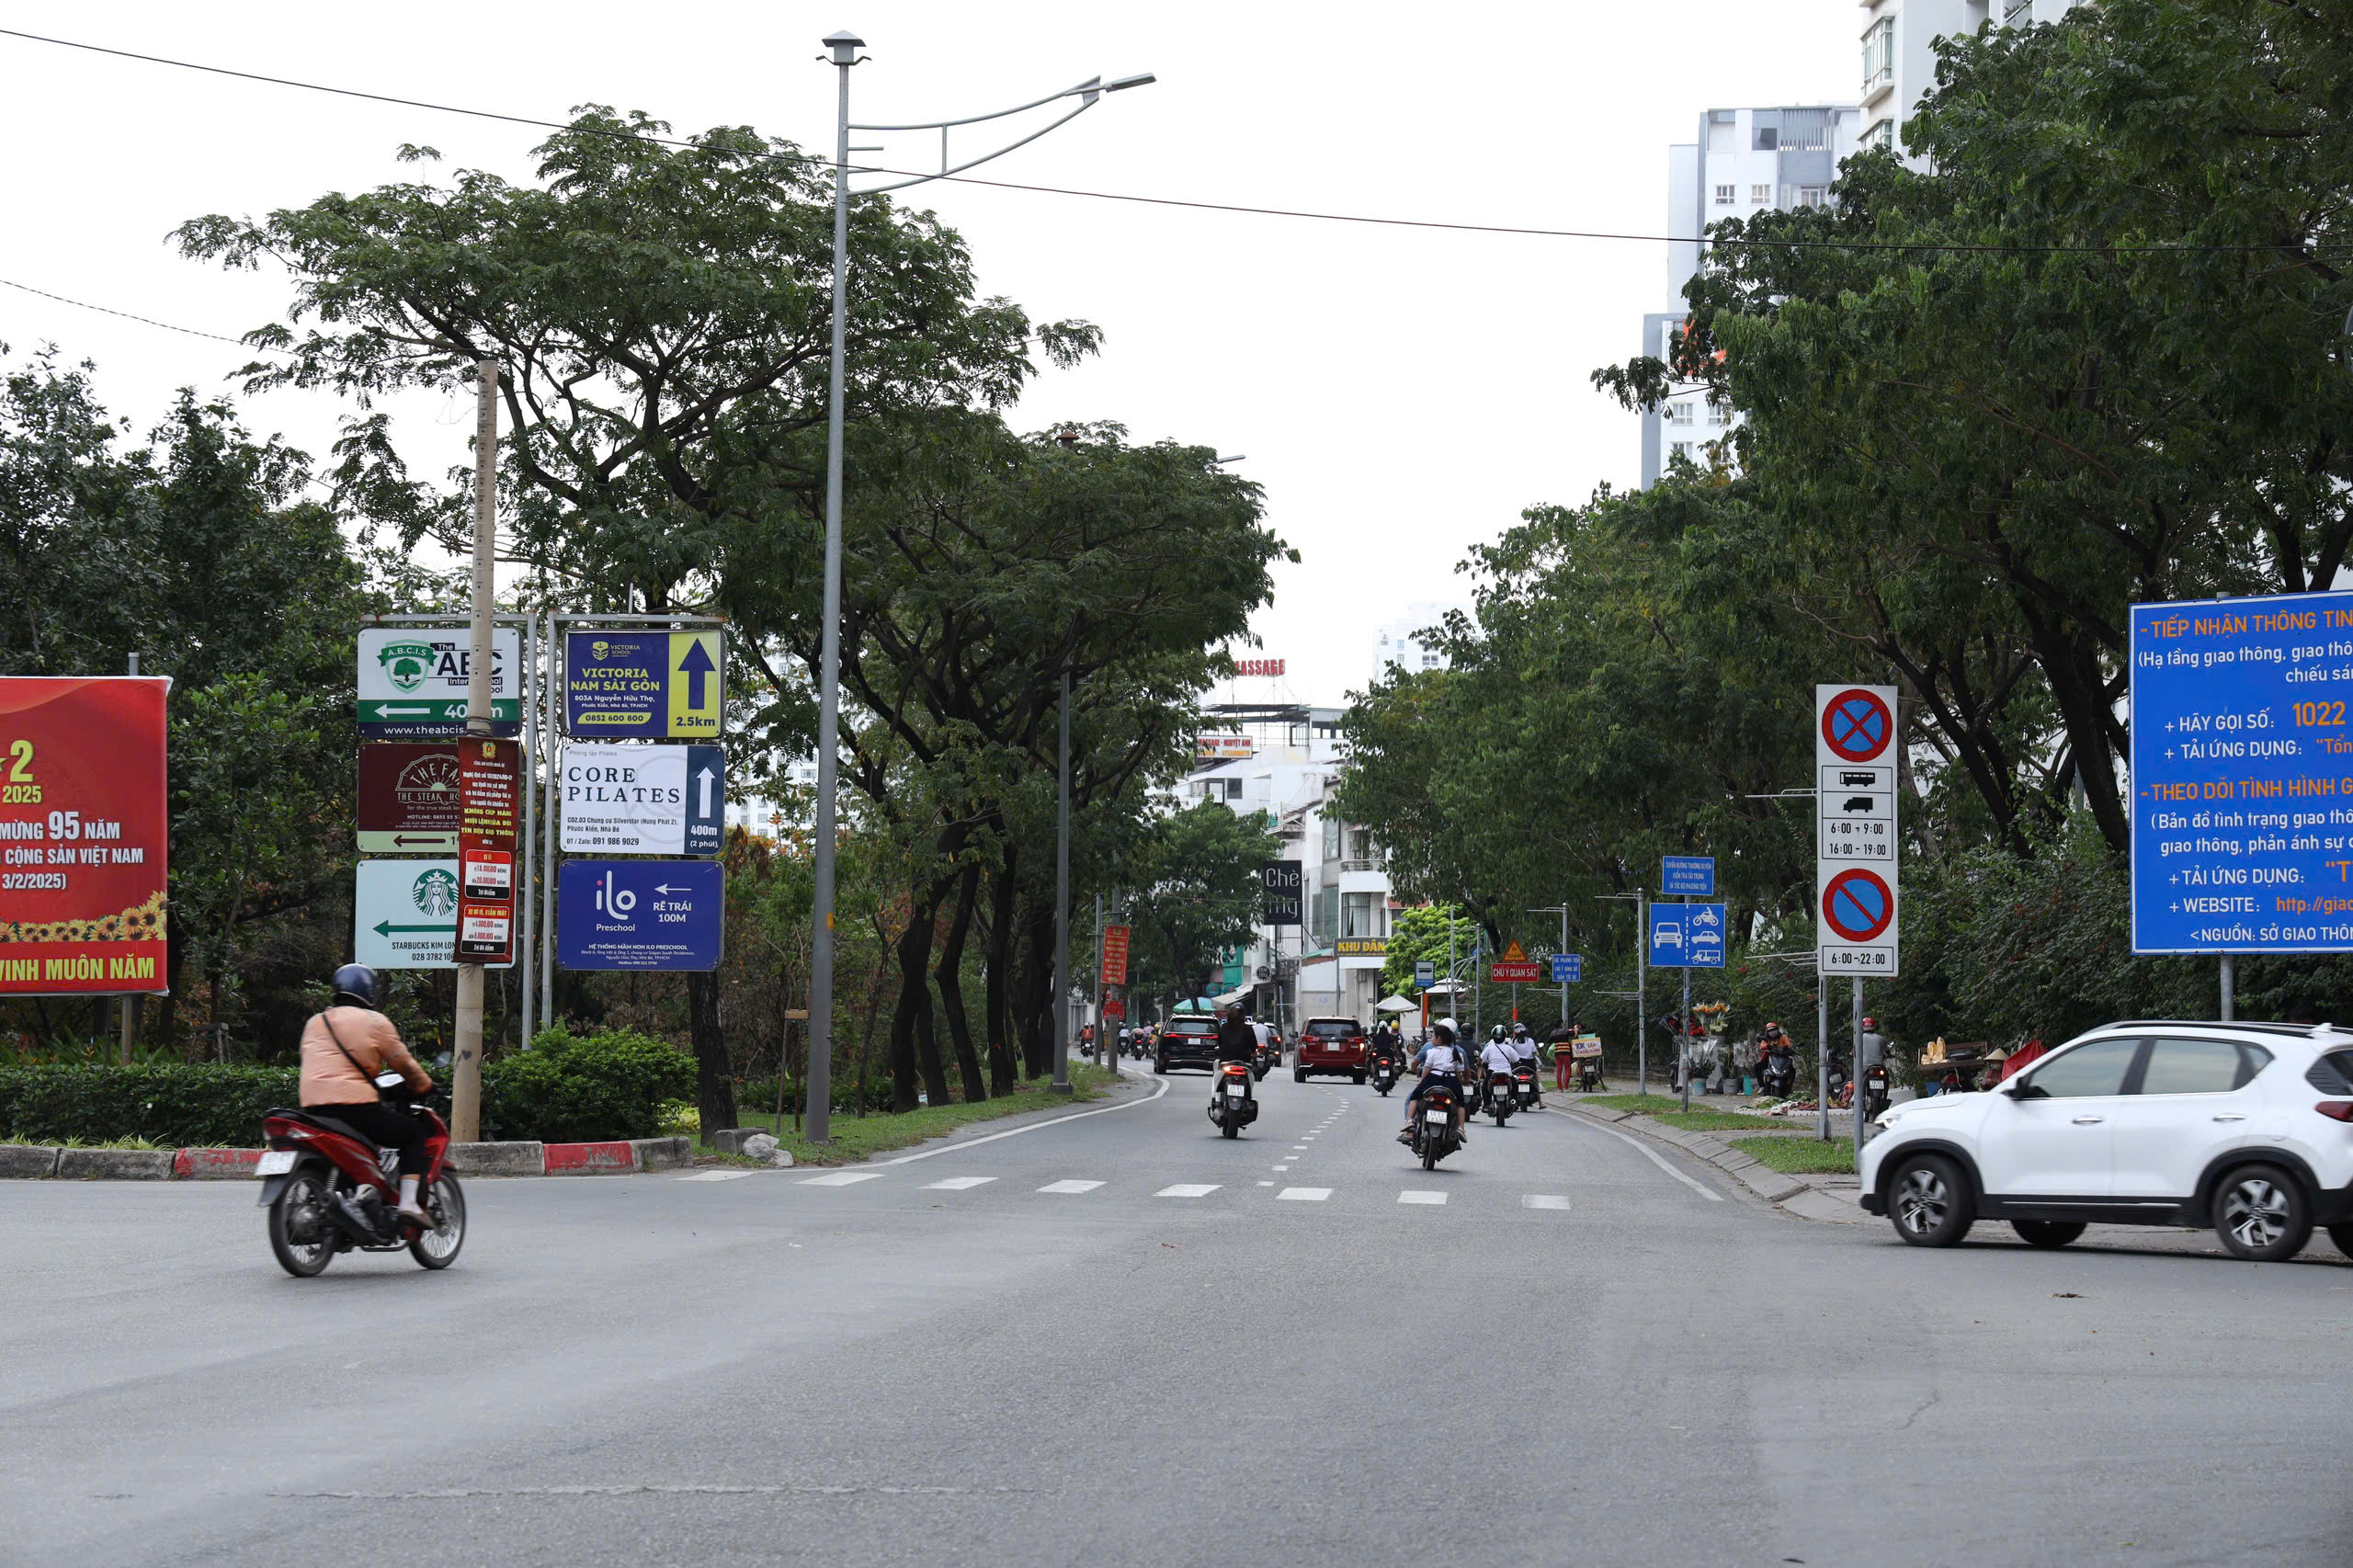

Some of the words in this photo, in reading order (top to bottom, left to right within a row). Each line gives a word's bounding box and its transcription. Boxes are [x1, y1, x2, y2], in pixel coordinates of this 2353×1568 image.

[2151, 613, 2189, 638] TIẾP
[2195, 613, 2247, 639] NHẬN
[2253, 609, 2316, 631] THÔNG
[2324, 610, 2353, 628] TIN
[387, 647, 427, 656] A.B.C.I.S
[2138, 651, 2163, 669] (Hạ
[2167, 647, 2200, 668] tầng
[2203, 652, 2234, 667] giao
[2239, 646, 2287, 663] thông,
[2291, 643, 2324, 662] giao
[582, 668, 649, 677] VICTORIA
[2285, 664, 2328, 683] chiếu
[571, 681, 598, 691] NAM
[603, 678, 626, 691] SÀI
[631, 678, 660, 691] GÒN
[595, 694, 621, 703] Nguyễn
[640, 695, 655, 703] Thọ,
[444, 704, 503, 719] 40m
[2179, 712, 2211, 733] HÃY
[2215, 714, 2242, 733] GỌI
[2246, 706, 2275, 729] SỐ:
[2292, 700, 2347, 727] 1022
[676, 716, 716, 727] 2.5km
[2180, 739, 2205, 759] TẢI
[2209, 739, 2245, 758] ỨNG
[2249, 740, 2302, 760] DỤNG:
[568, 767, 636, 782] CORE
[2, 786, 42, 803] 2025
[567, 786, 680, 803] PILATES
[2151, 783, 2199, 801] THEO
[2203, 777, 2234, 799] DÕI
[2238, 777, 2282, 798] TÌNH
[2288, 774, 2336, 796] HÌNH
[397, 792, 412, 801] THE
[417, 792, 442, 802] STEAK
[49, 811, 80, 840] 95
[85, 819, 120, 839] NĂM
[2192, 811, 2211, 827] đồ
[2214, 812, 2244, 827] tình
[2247, 812, 2288, 829] trạng
[2292, 812, 2325, 829] giao
[690, 824, 718, 835] 400m
[1831, 823, 1851, 834] 6:00
[1864, 824, 1883, 835] 9:00
[622, 837, 640, 846] 9029
[1829, 843, 1852, 855] 16:00
[1864, 844, 1886, 855] 19:00
[2160, 840, 2192, 857] giao
[2196, 836, 2243, 856] thông,
[2248, 834, 2286, 855] phản
[2290, 834, 2319, 850] ánh
[2325, 835, 2345, 853] sự
[5, 846, 43, 868] CỘNG
[47, 844, 75, 864] SẢN
[79, 845, 108, 868] VIỆT
[111, 847, 143, 864] NAM
[2, 873, 67, 890] 3/2/2025)
[1266, 868, 1300, 887] Chè
[2182, 865, 2207, 885] TẢI
[2211, 865, 2247, 885] ỨNG
[2252, 868, 2305, 888] DỤNG:
[596, 869, 636, 920] ilo
[654, 901, 665, 911] RẼ
[667, 900, 691, 911] TRÁI
[2183, 896, 2260, 913] WEBSITE:
[658, 914, 686, 923] 100M
[597, 924, 635, 932] Preschool
[2259, 923, 2279, 942] SỞ
[2282, 926, 2316, 941] GIAO
[1338, 941, 1360, 952] KHU
[46, 953, 104, 981] MUÔN
[109, 952, 154, 979] NĂM
[1493, 966, 1504, 977] CHÚ
[1505, 966, 1509, 977] Ý
[1509, 968, 1525, 977] QUAN
[1526, 966, 1537, 977] SÁT
